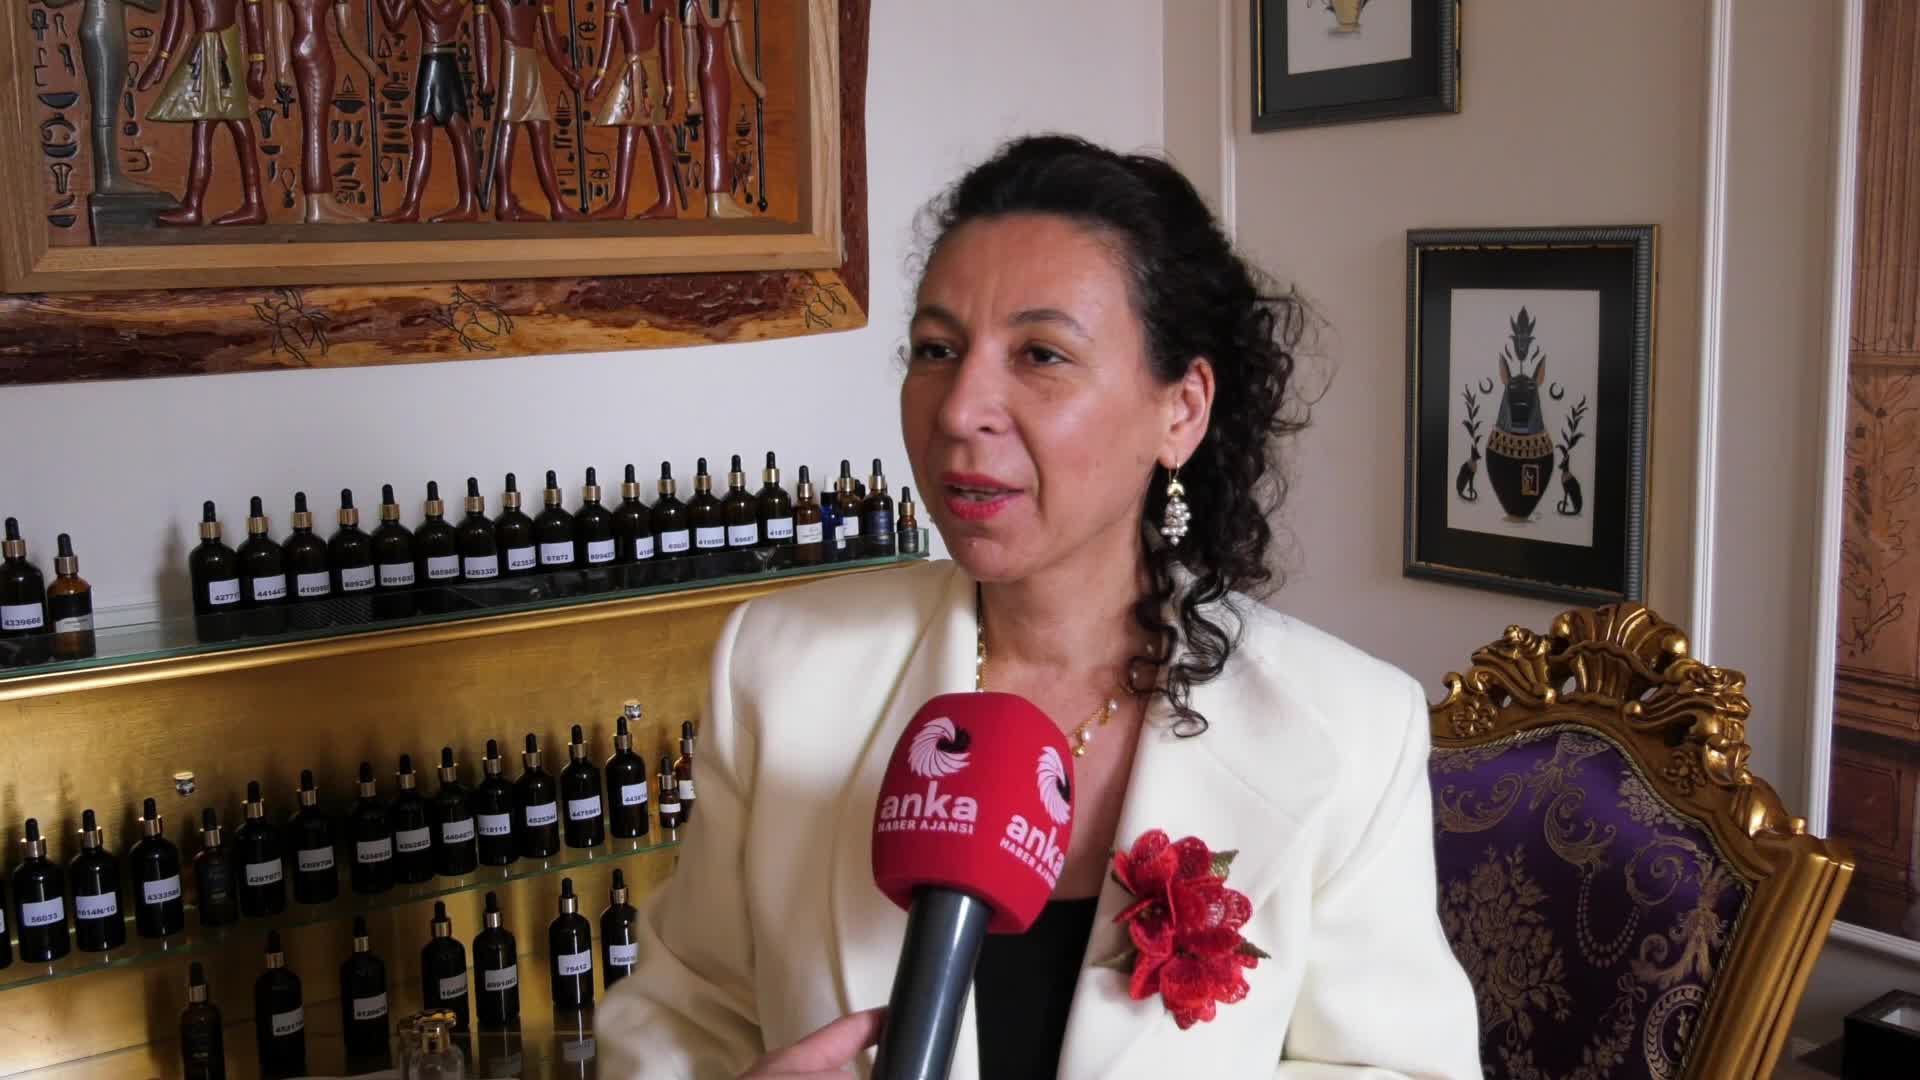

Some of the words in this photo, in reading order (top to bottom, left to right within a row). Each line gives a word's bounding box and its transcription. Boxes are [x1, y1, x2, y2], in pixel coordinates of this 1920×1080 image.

[880, 780, 978, 822] anka
[878, 820, 916, 832] HABER
[919, 820, 974, 835] AJANSI
[1000, 837, 1036, 867] HABER
[1006, 814, 1065, 879] anka
